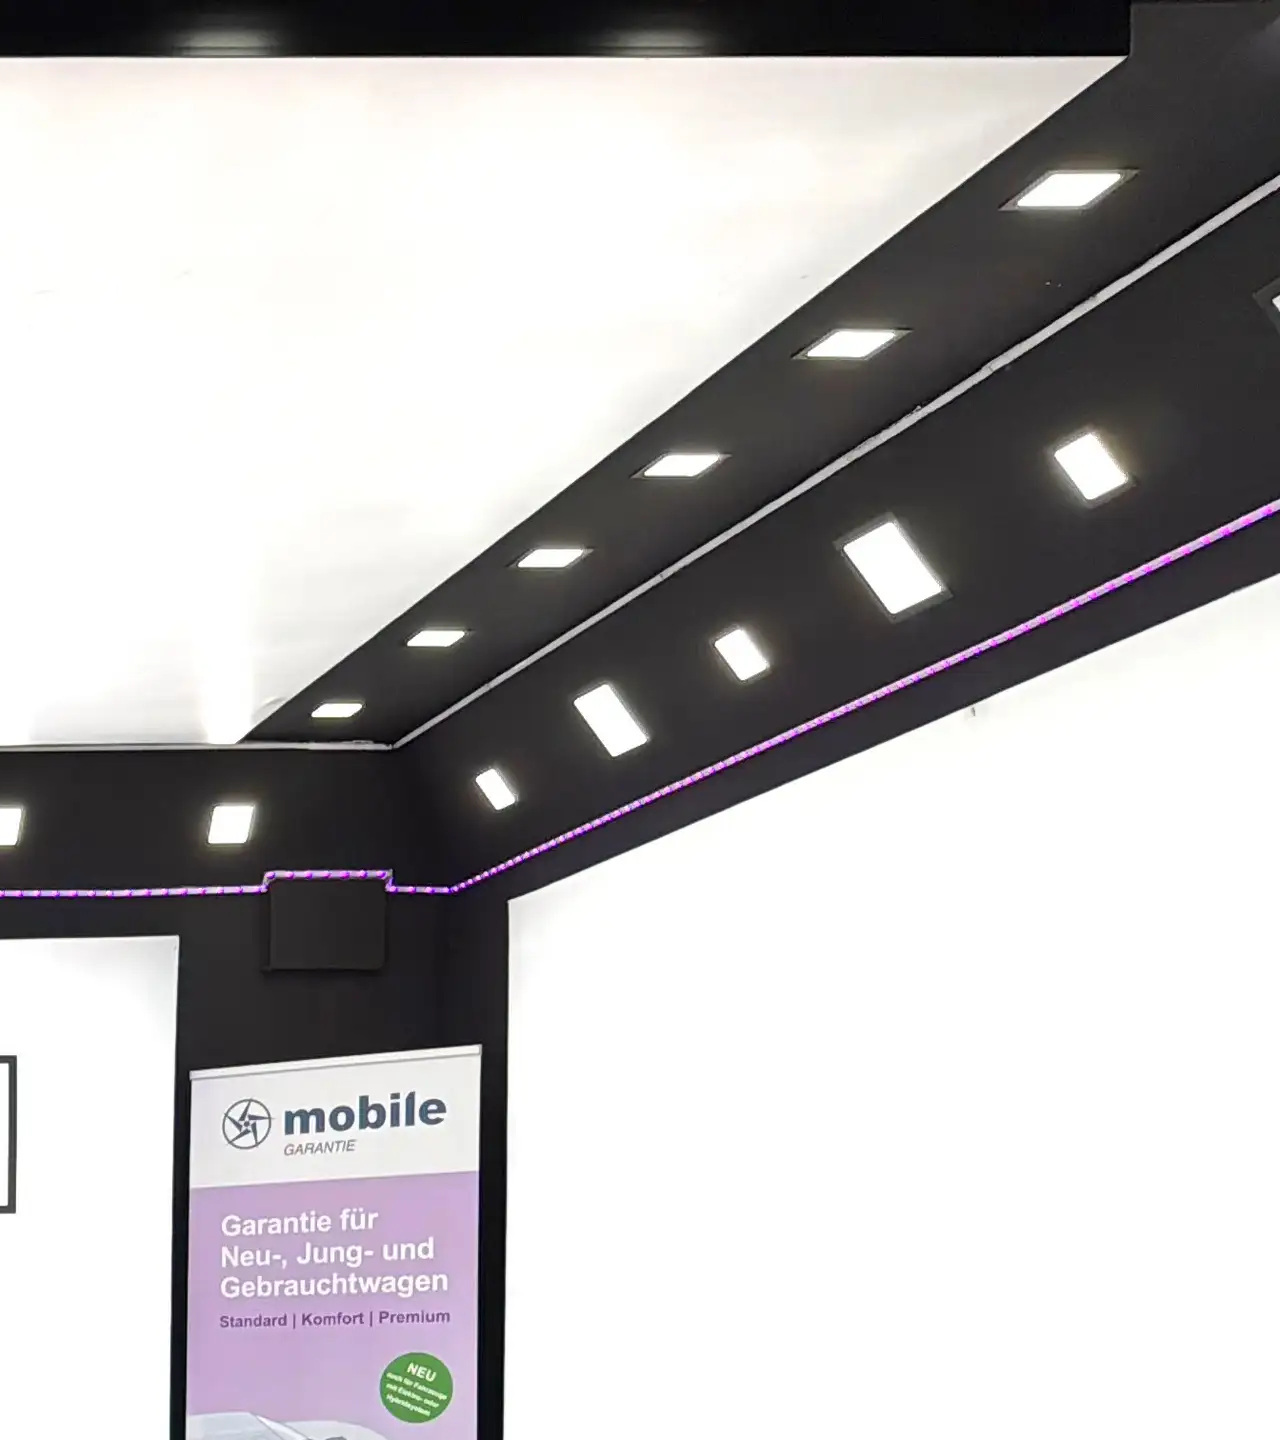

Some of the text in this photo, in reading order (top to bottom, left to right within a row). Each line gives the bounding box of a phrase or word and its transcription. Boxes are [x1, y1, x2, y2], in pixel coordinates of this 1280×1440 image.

[284, 1091, 447, 1136] mobile
[283, 1138, 357, 1157] GARANTIE
[221, 1207, 379, 1237] Garantie für
[221, 1236, 434, 1270] Neu-, Jung- und
[220, 1272, 448, 1299] Gebrauchtwagen
[219, 1313, 288, 1329] Standard
[301, 1311, 365, 1327] Komfort
[378, 1309, 451, 1325] Premium
[406, 1361, 437, 1383] NEU
